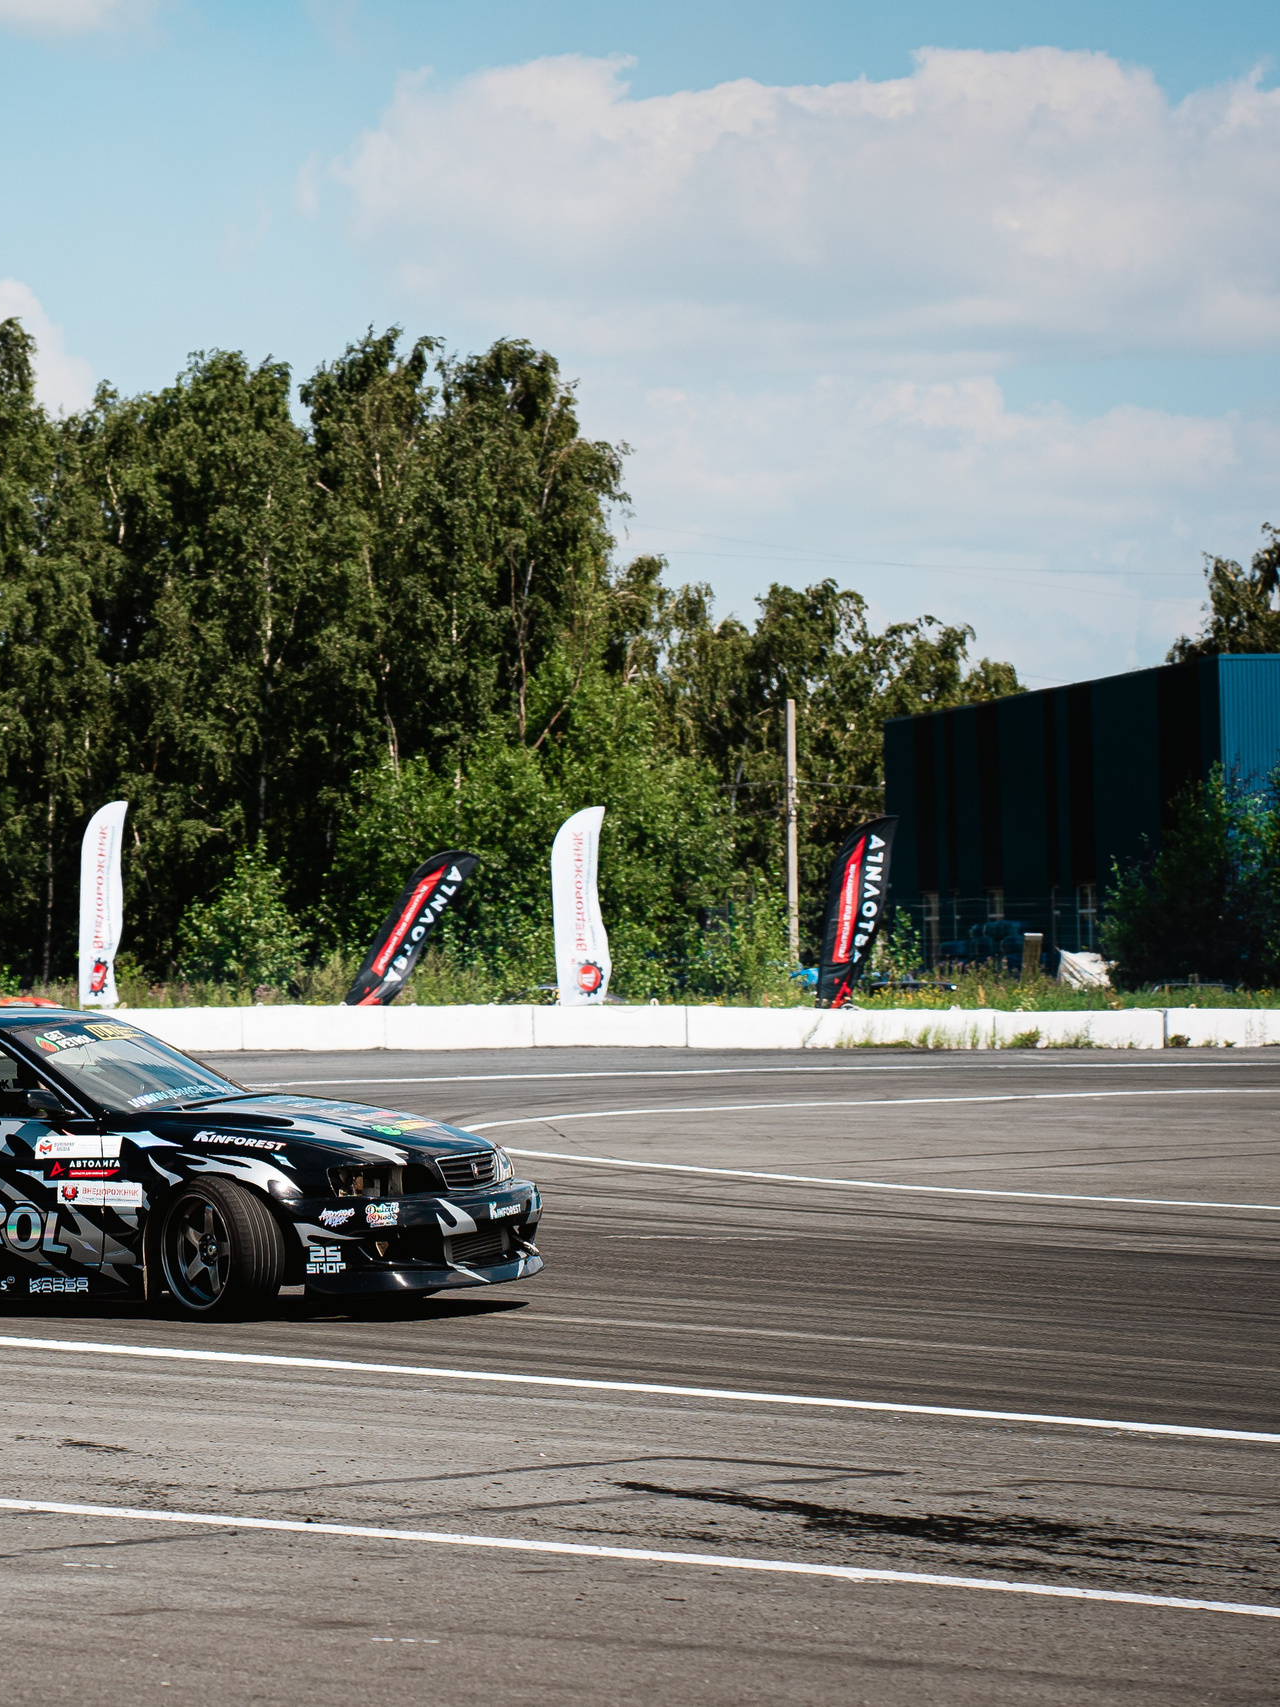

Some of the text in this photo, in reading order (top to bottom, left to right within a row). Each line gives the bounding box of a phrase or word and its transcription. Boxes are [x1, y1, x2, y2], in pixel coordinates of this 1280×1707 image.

[92, 825, 109, 949] ВНЕДОРОЖНИК
[572, 831, 587, 952] ВНЕДОРОЖНИК
[43, 1030, 66, 1041] GET
[56, 1034, 96, 1049] PETROL
[192, 1130, 287, 1151] KINFOREST
[69, 1159, 121, 1168] АВТОЛИГА
[81, 1187, 139, 1197] ВНЕДОРОЖНИК
[309, 1246, 342, 1262] 25
[306, 1262, 347, 1274] SHOP
